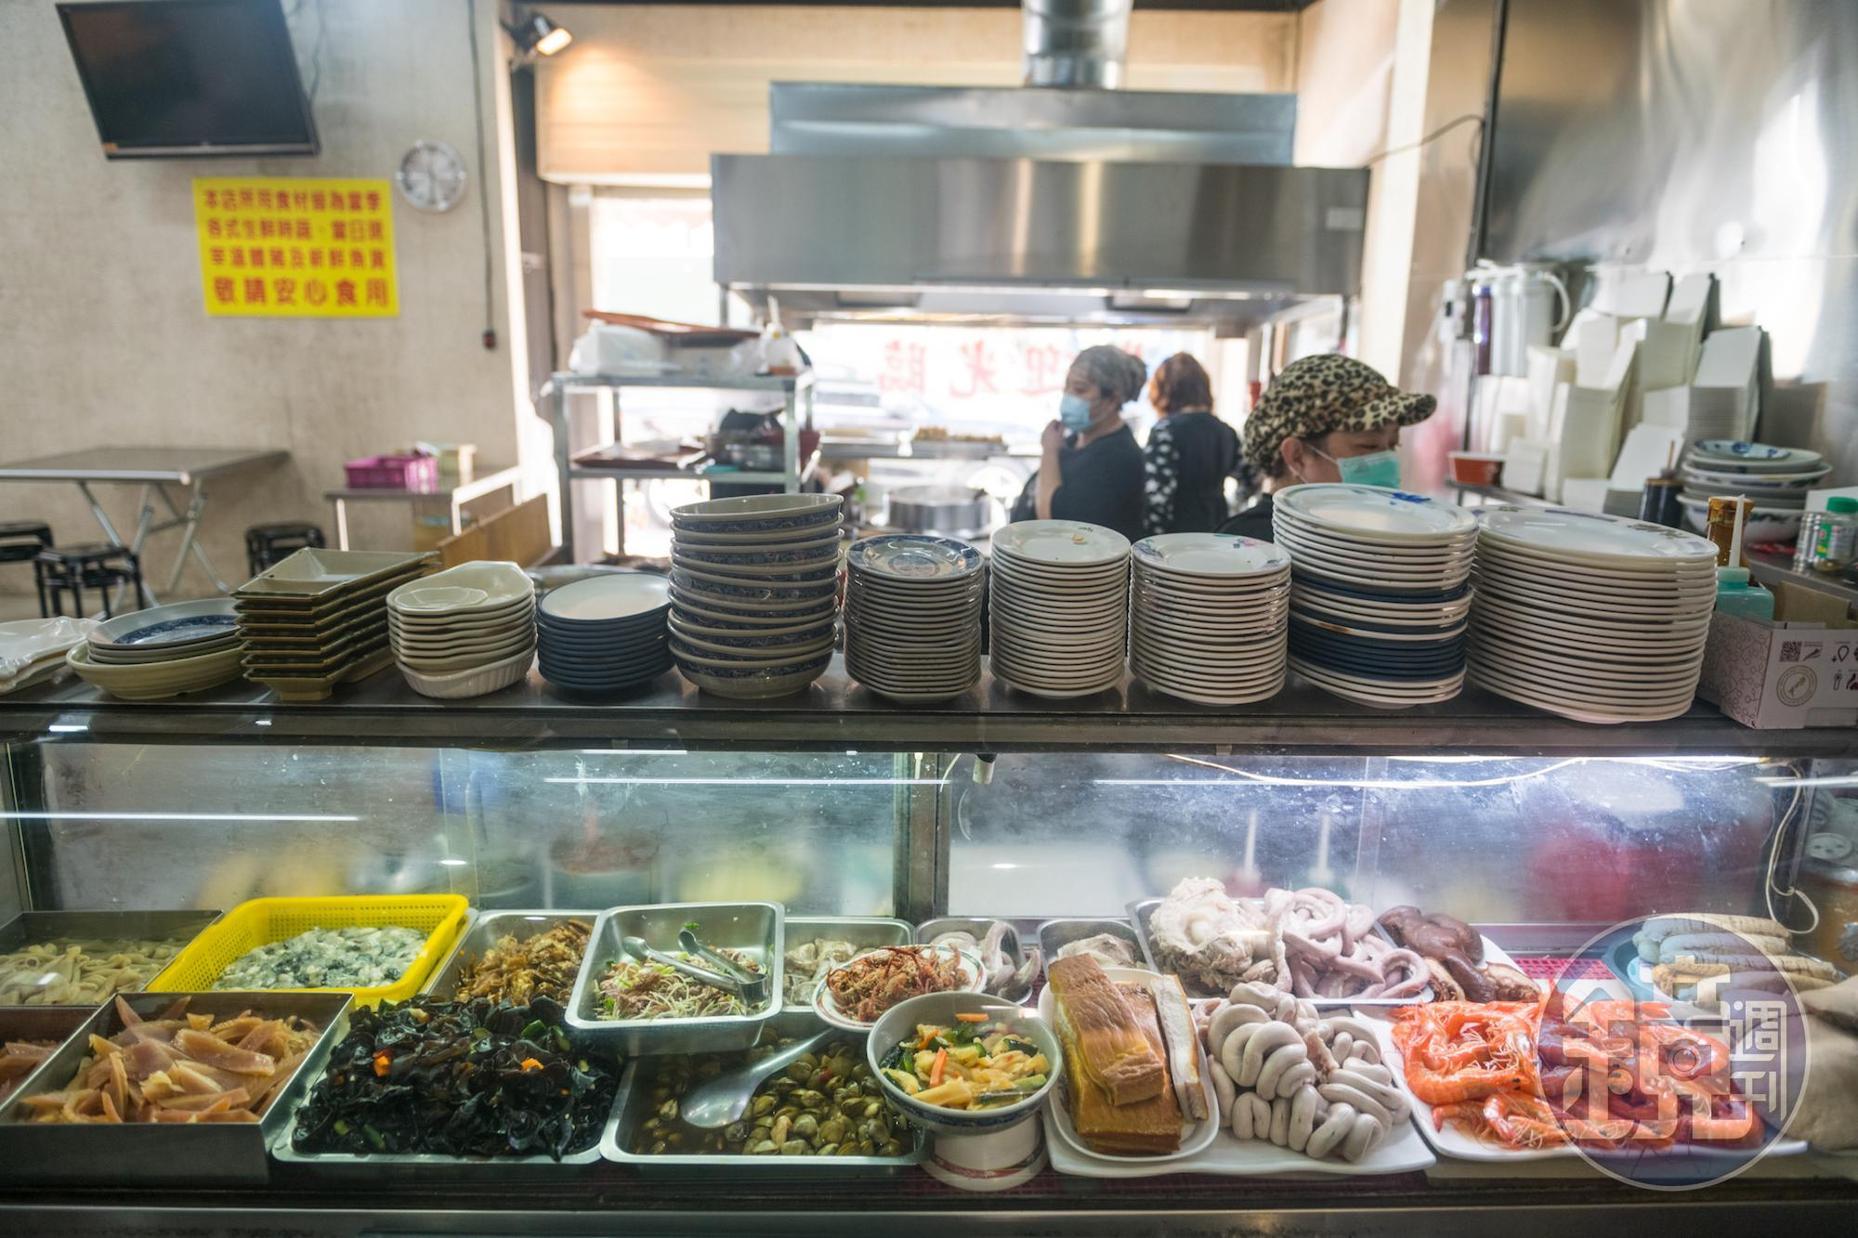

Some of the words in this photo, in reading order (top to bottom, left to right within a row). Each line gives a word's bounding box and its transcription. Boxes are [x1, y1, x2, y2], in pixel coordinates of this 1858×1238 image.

[213, 275, 388, 306] 敬請安心食用
